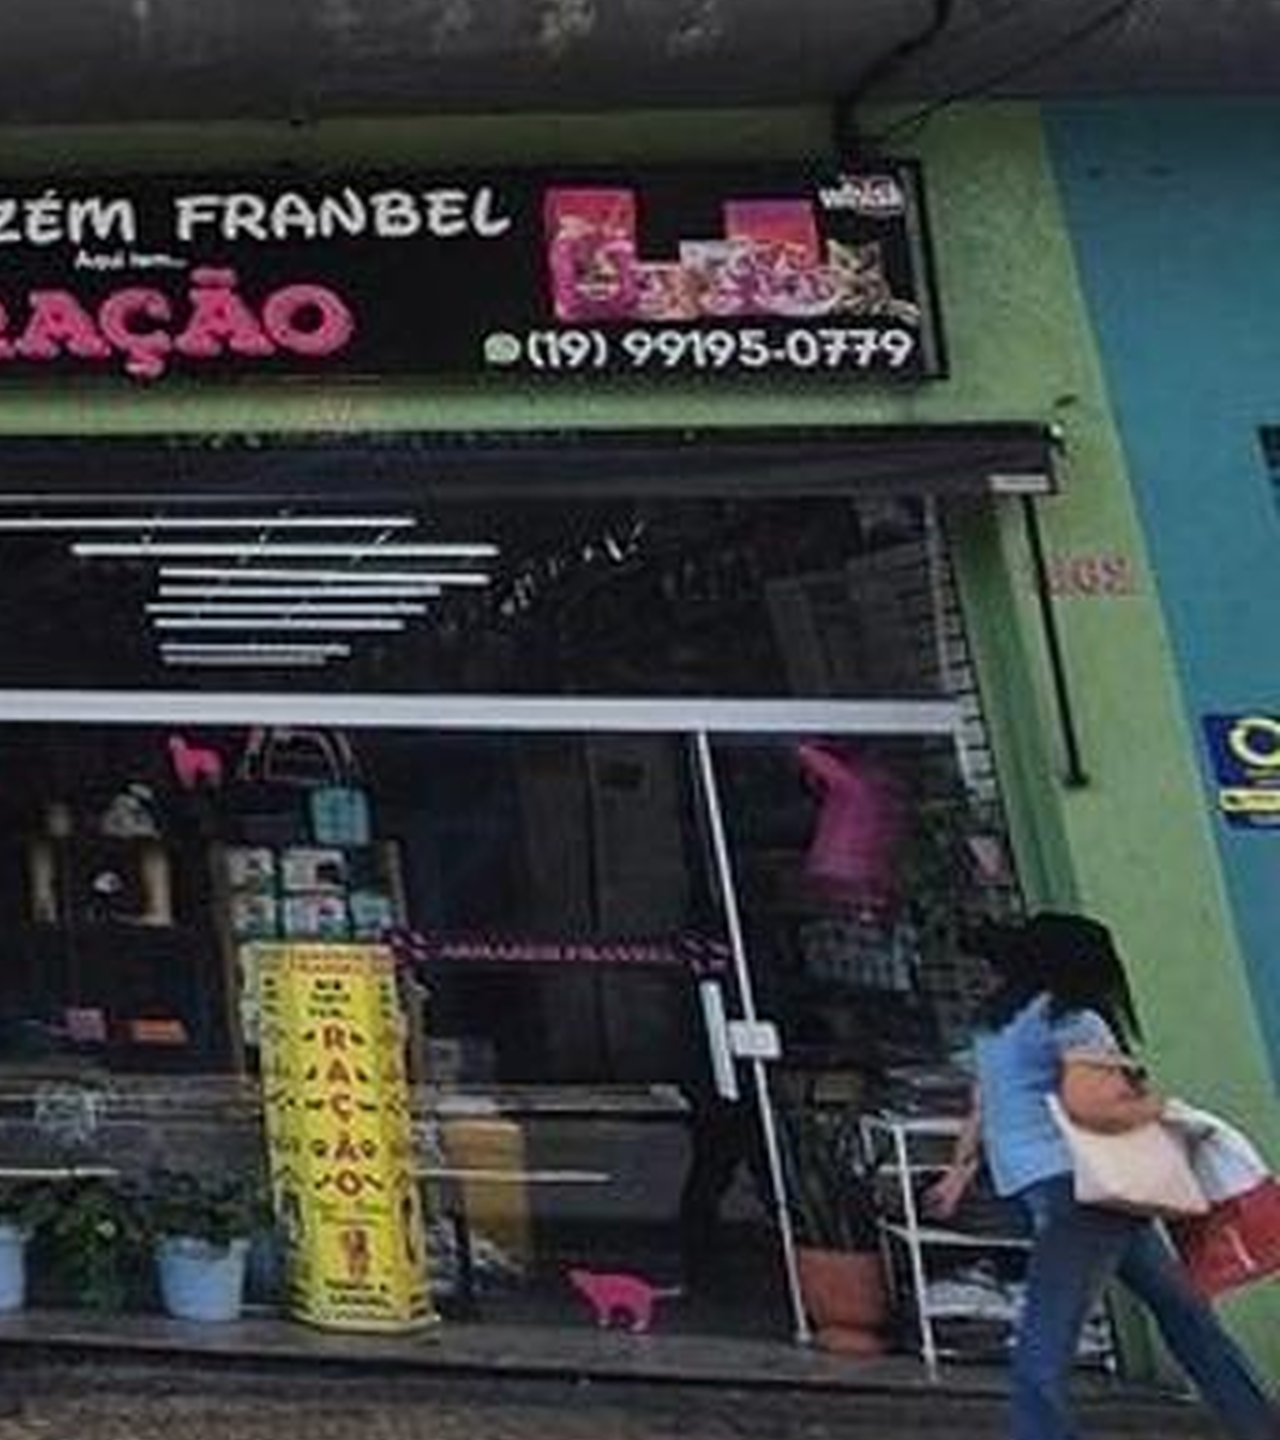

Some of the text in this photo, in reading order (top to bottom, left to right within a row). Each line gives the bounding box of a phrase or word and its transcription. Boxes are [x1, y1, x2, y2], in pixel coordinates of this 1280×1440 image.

[175, 186, 512, 242] FRANBEL
[526, 328, 916, 368] (19) 99195-0779
